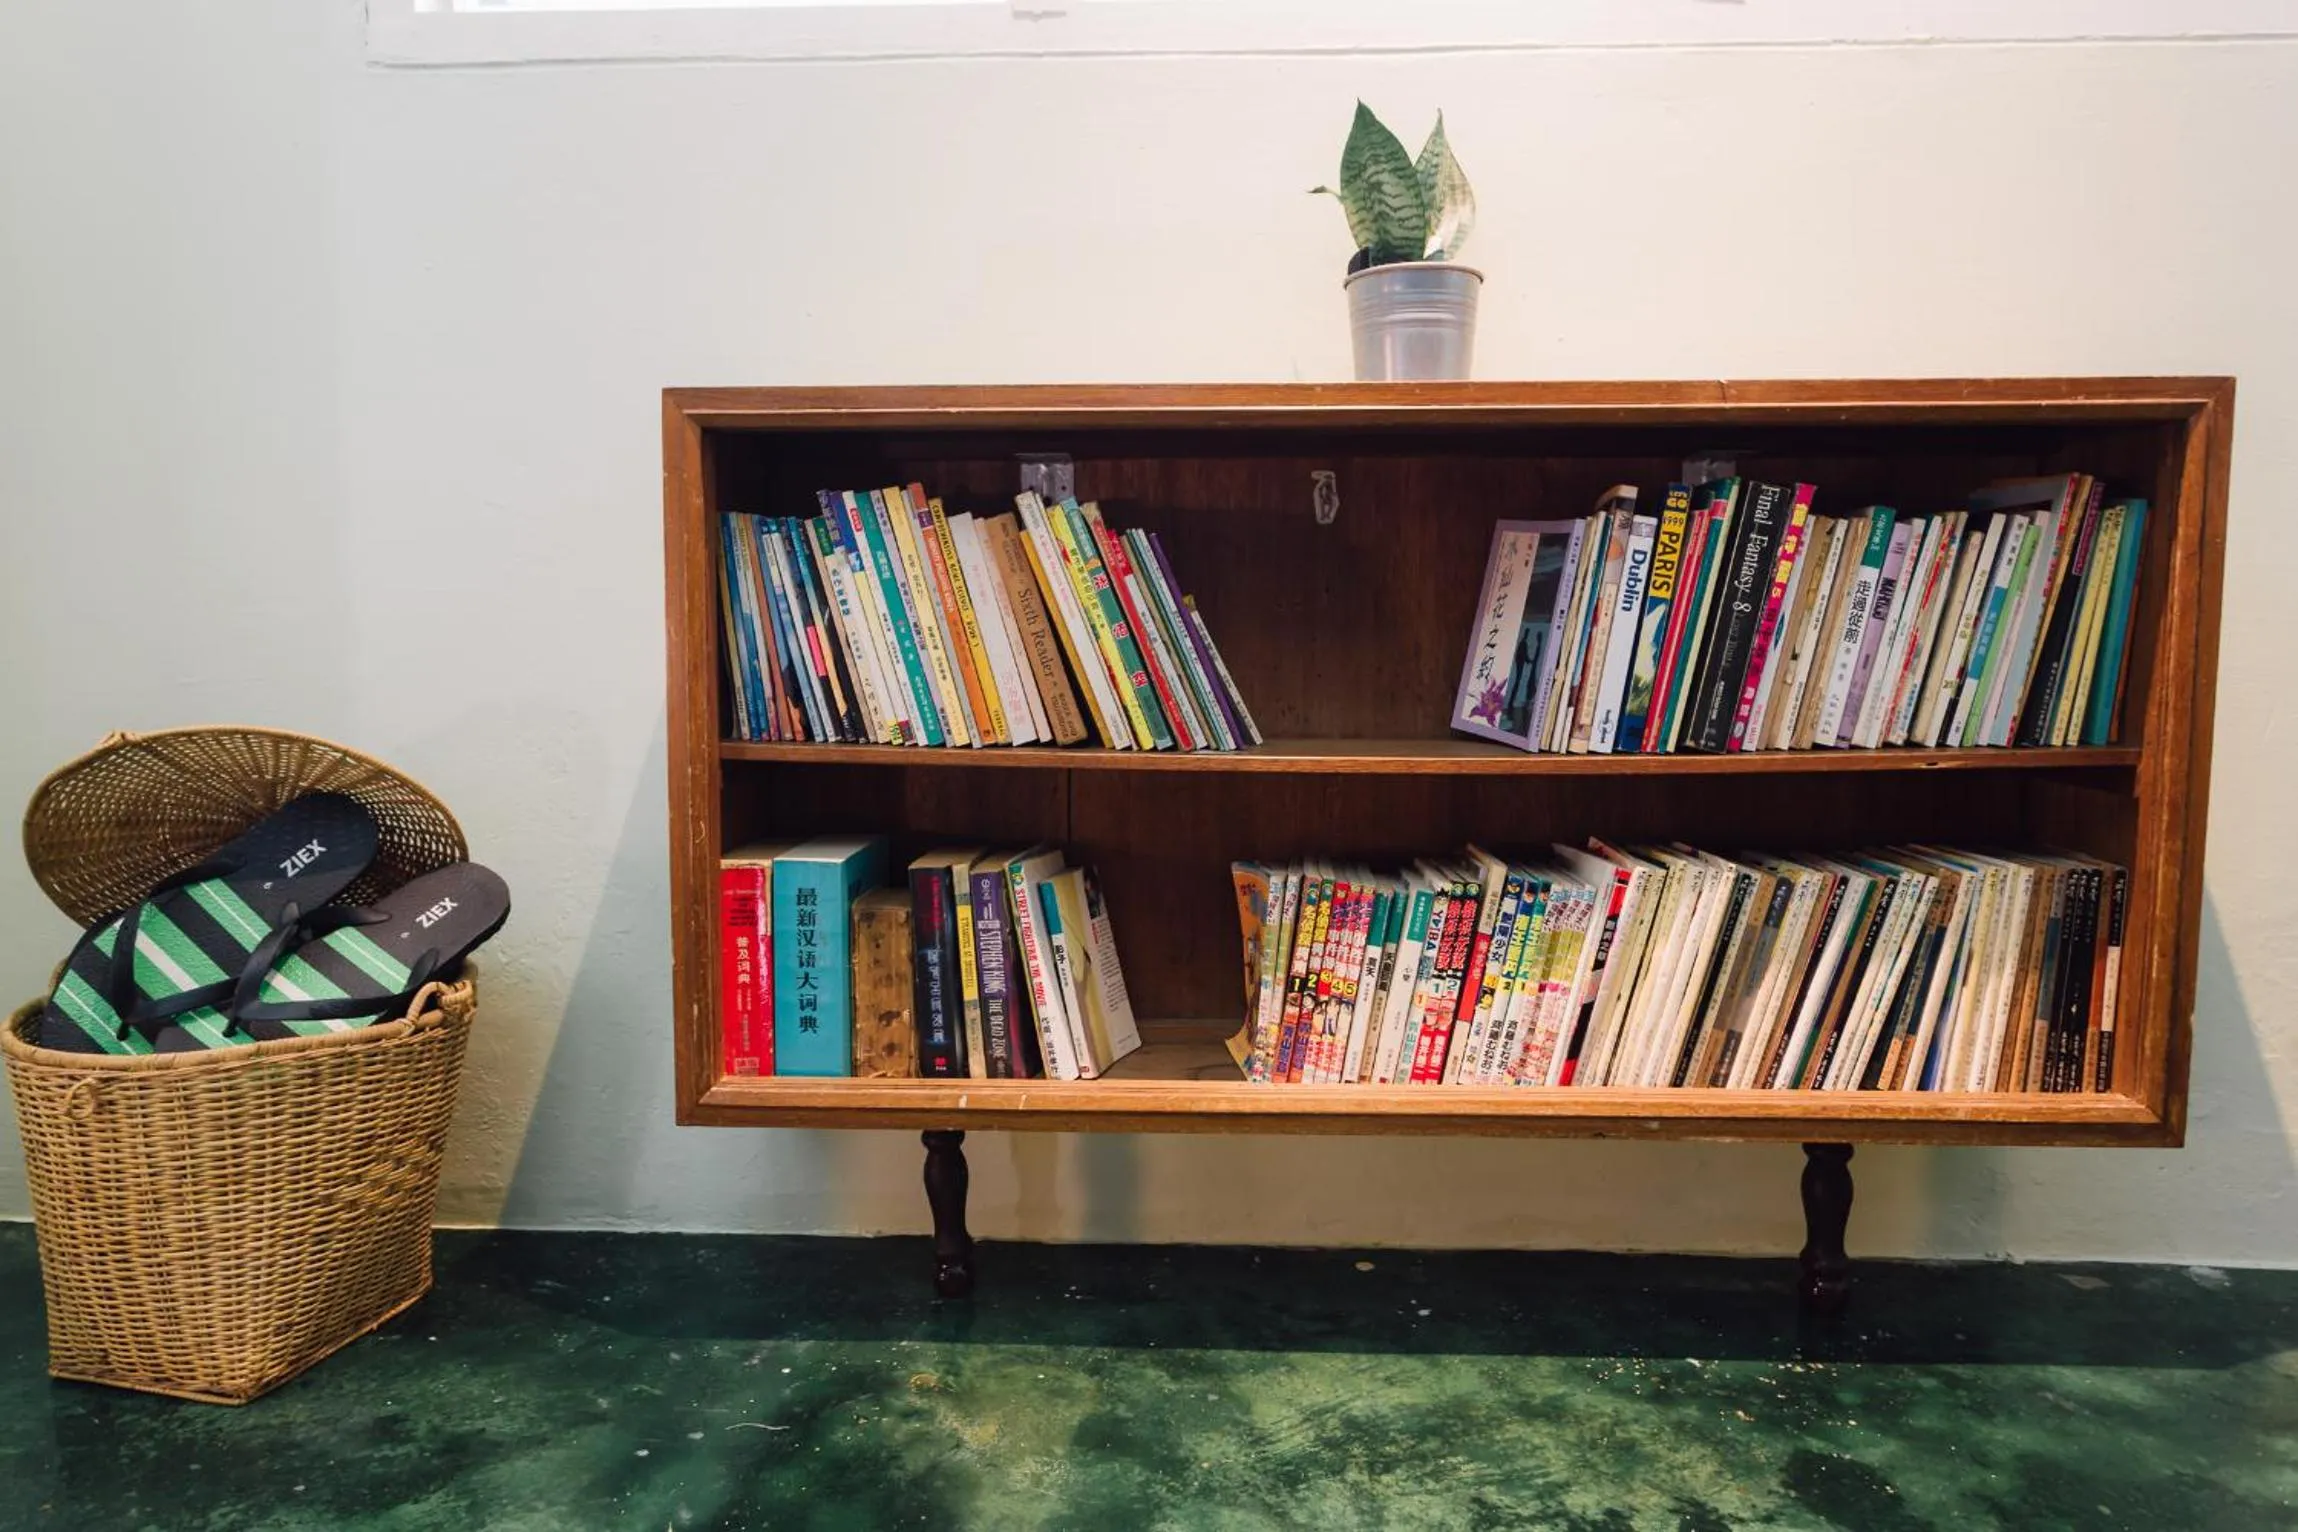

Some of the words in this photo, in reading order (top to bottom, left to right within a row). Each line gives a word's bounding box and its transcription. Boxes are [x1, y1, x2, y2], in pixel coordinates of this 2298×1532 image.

[1666, 498, 1688, 509] GO
[1753, 483, 1780, 525] Final
[1663, 515, 1684, 527] 1999
[1652, 530, 1681, 593] PARIS
[1734, 532, 1769, 593] Fantasy
[1622, 548, 1648, 612] Dublin
[1732, 600, 1752, 613] 8
[1018, 587, 1041, 626] Sixth
[1030, 627, 1055, 678] Reader
[279, 838, 327, 878] ZIEX
[415, 897, 458, 928] ZIEX
[1014, 888, 1030, 921] STREET
[1425, 910, 1444, 951] YAIBA
[796, 887, 819, 1034] 最新汉语大词典
[979, 930, 1005, 968] STEPHEN
[984, 968, 1006, 995] KING
[1293, 978, 1300, 991] 1
[1307, 973, 1318, 988] 2
[1433, 983, 1440, 994] 1
[1447, 980, 1458, 991] 2
[1503, 981, 1512, 991] 2
[989, 998, 1004, 1013] THE
[990, 1014, 1005, 1036] DEAD
[991, 1036, 1007, 1059] ZONE
